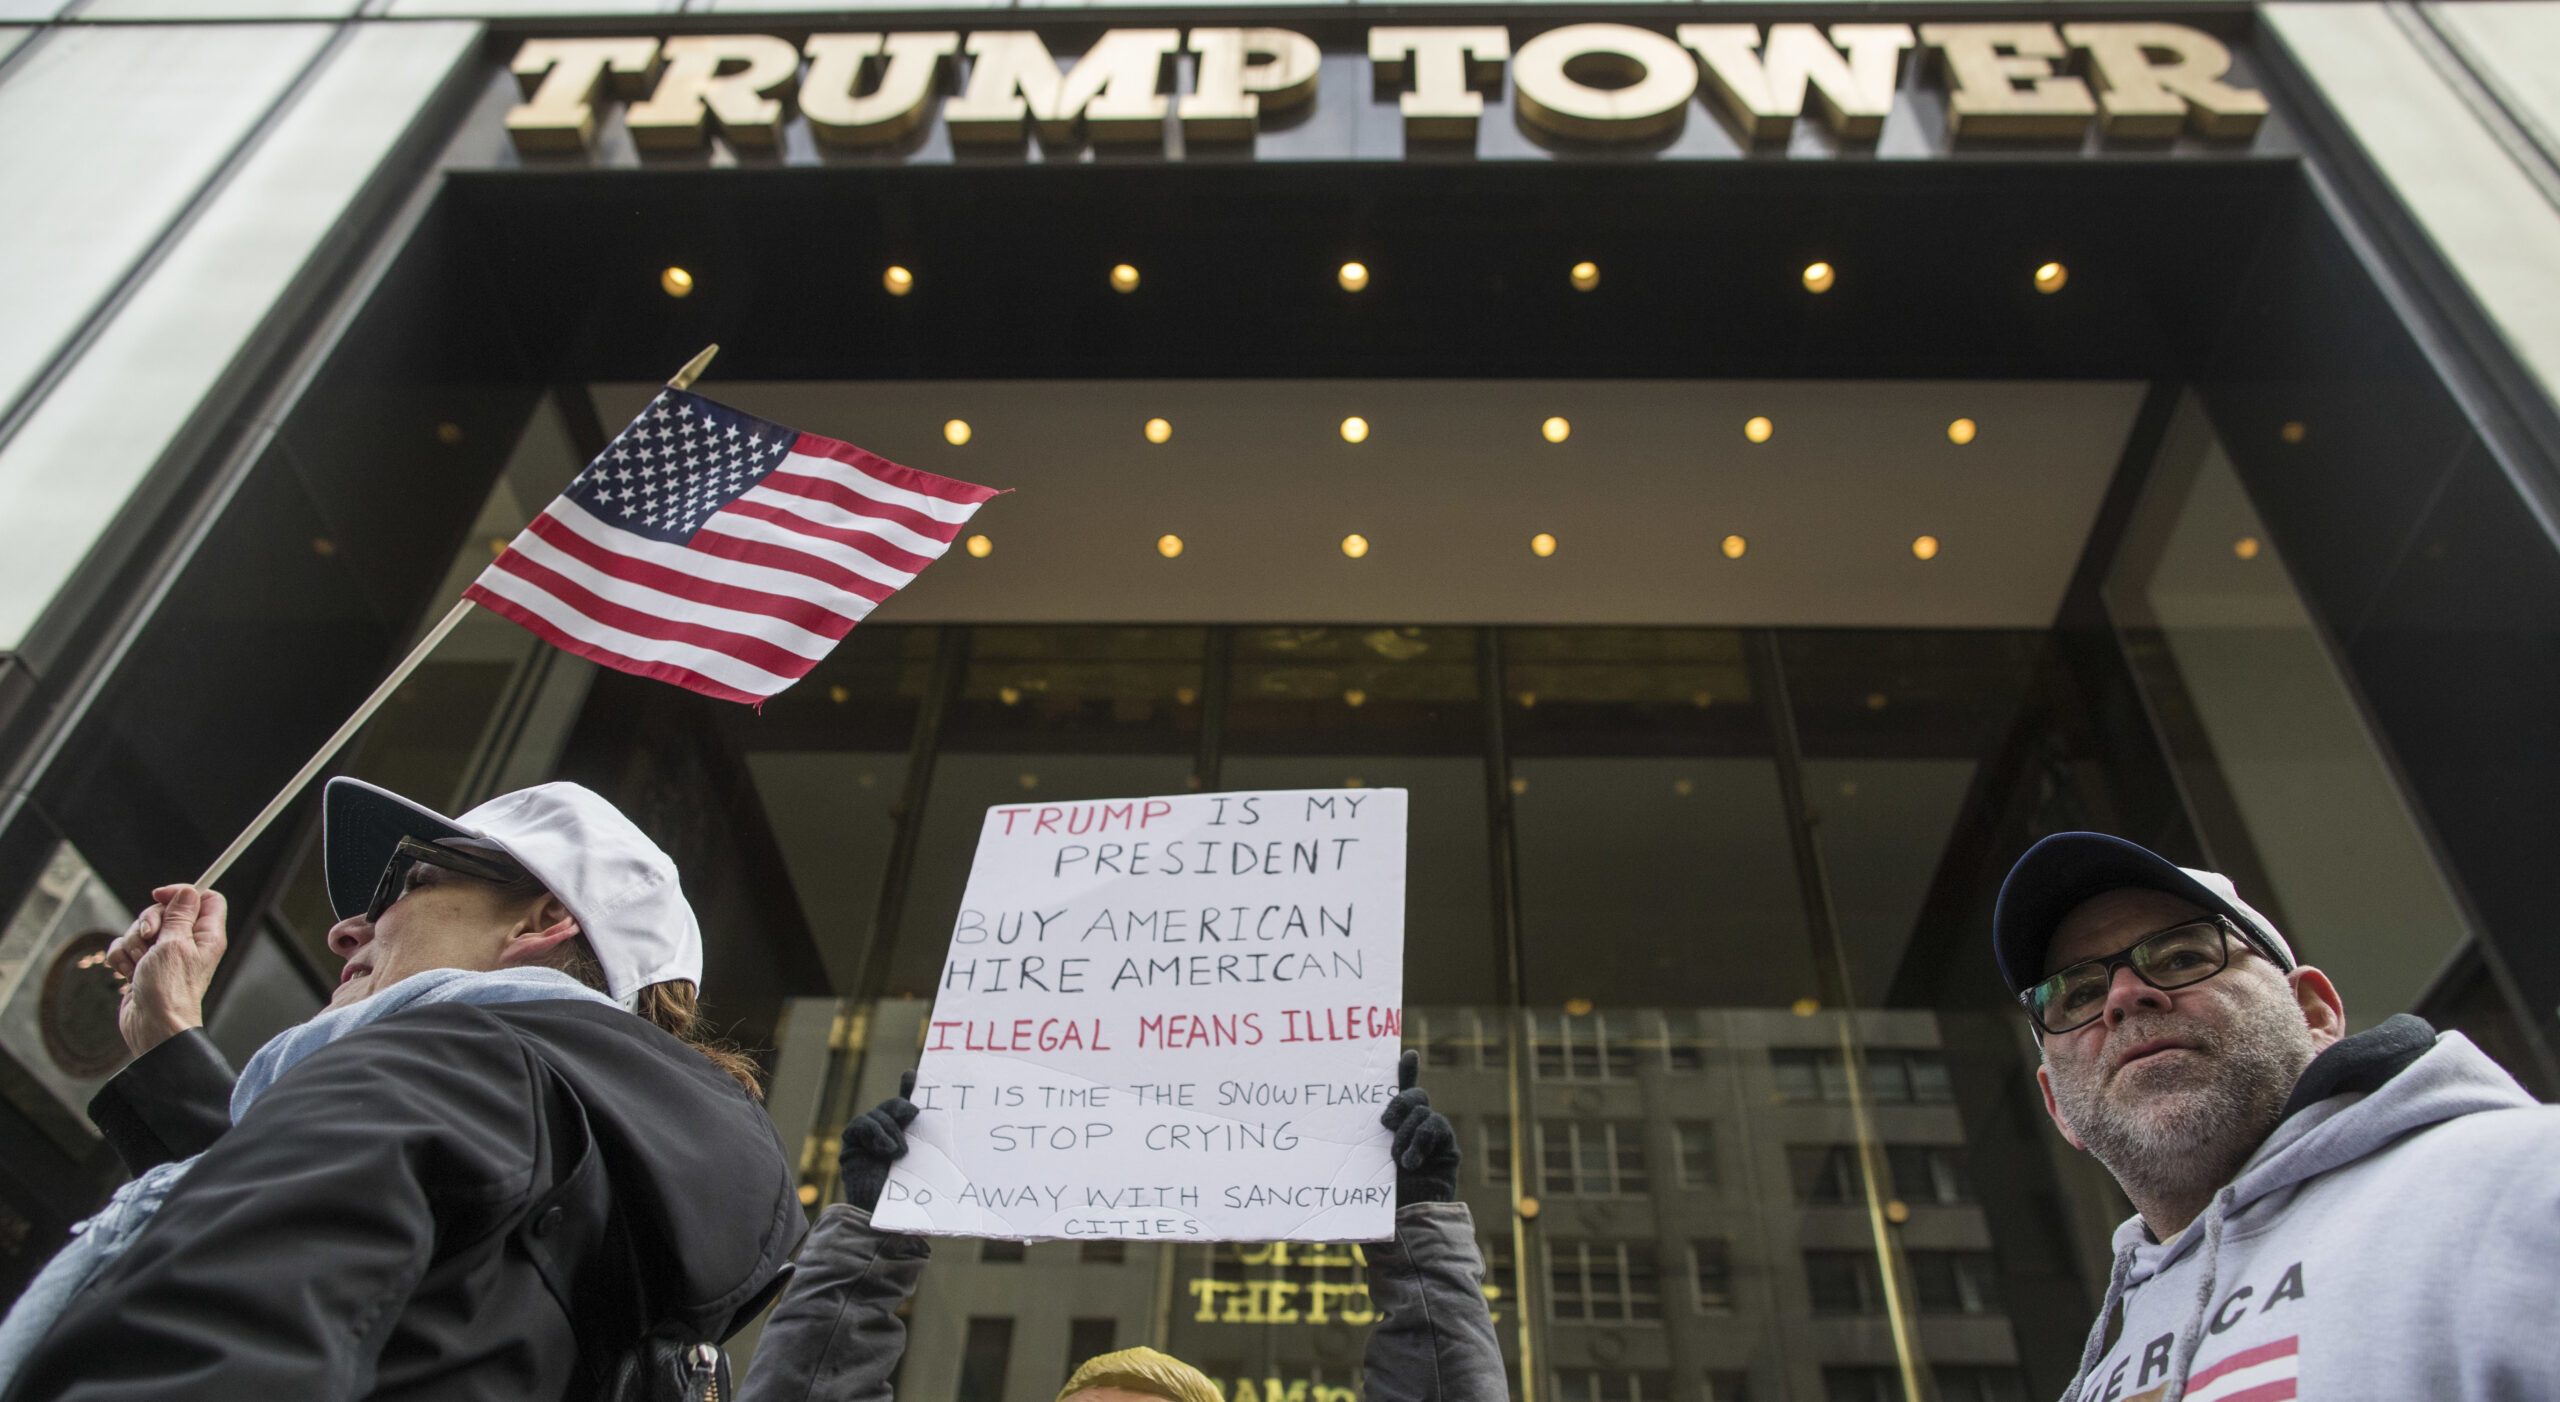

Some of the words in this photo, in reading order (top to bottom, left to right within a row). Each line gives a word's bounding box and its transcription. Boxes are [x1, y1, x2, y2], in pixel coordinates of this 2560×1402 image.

[504, 26, 1322, 152] TRUMP
[1368, 20, 2270, 144] TOWER
[994, 803, 1172, 836] TRUMP
[1207, 796, 1260, 826] IS
[1305, 795, 1367, 822] MY
[1053, 838, 1360, 878] PRESIDENT
[950, 906, 1068, 945] BUY
[1080, 903, 1354, 944] AMERICAN
[943, 953, 1091, 994] HIRE
[1110, 949, 1363, 992] AMERICAN
[924, 1015, 1112, 1053] ILLEGAL
[1138, 1012, 1264, 1050] MEANS
[915, 1081, 975, 1112] IT
[994, 1085, 1024, 1107] IS
[1038, 1086, 1111, 1108] TIME
[1129, 1083, 1196, 1107] THE
[989, 1122, 1113, 1152] STOP
[1145, 1120, 1299, 1153] CRYING
[883, 1176, 932, 1206] DO
[958, 1181, 1068, 1213] AWAY
[1086, 1185, 1199, 1210] WITH
[1224, 1184, 1392, 1209] SANCTUARY
[1064, 1218, 1199, 1236] CITIES
[1189, 1278, 1299, 1324] THE
